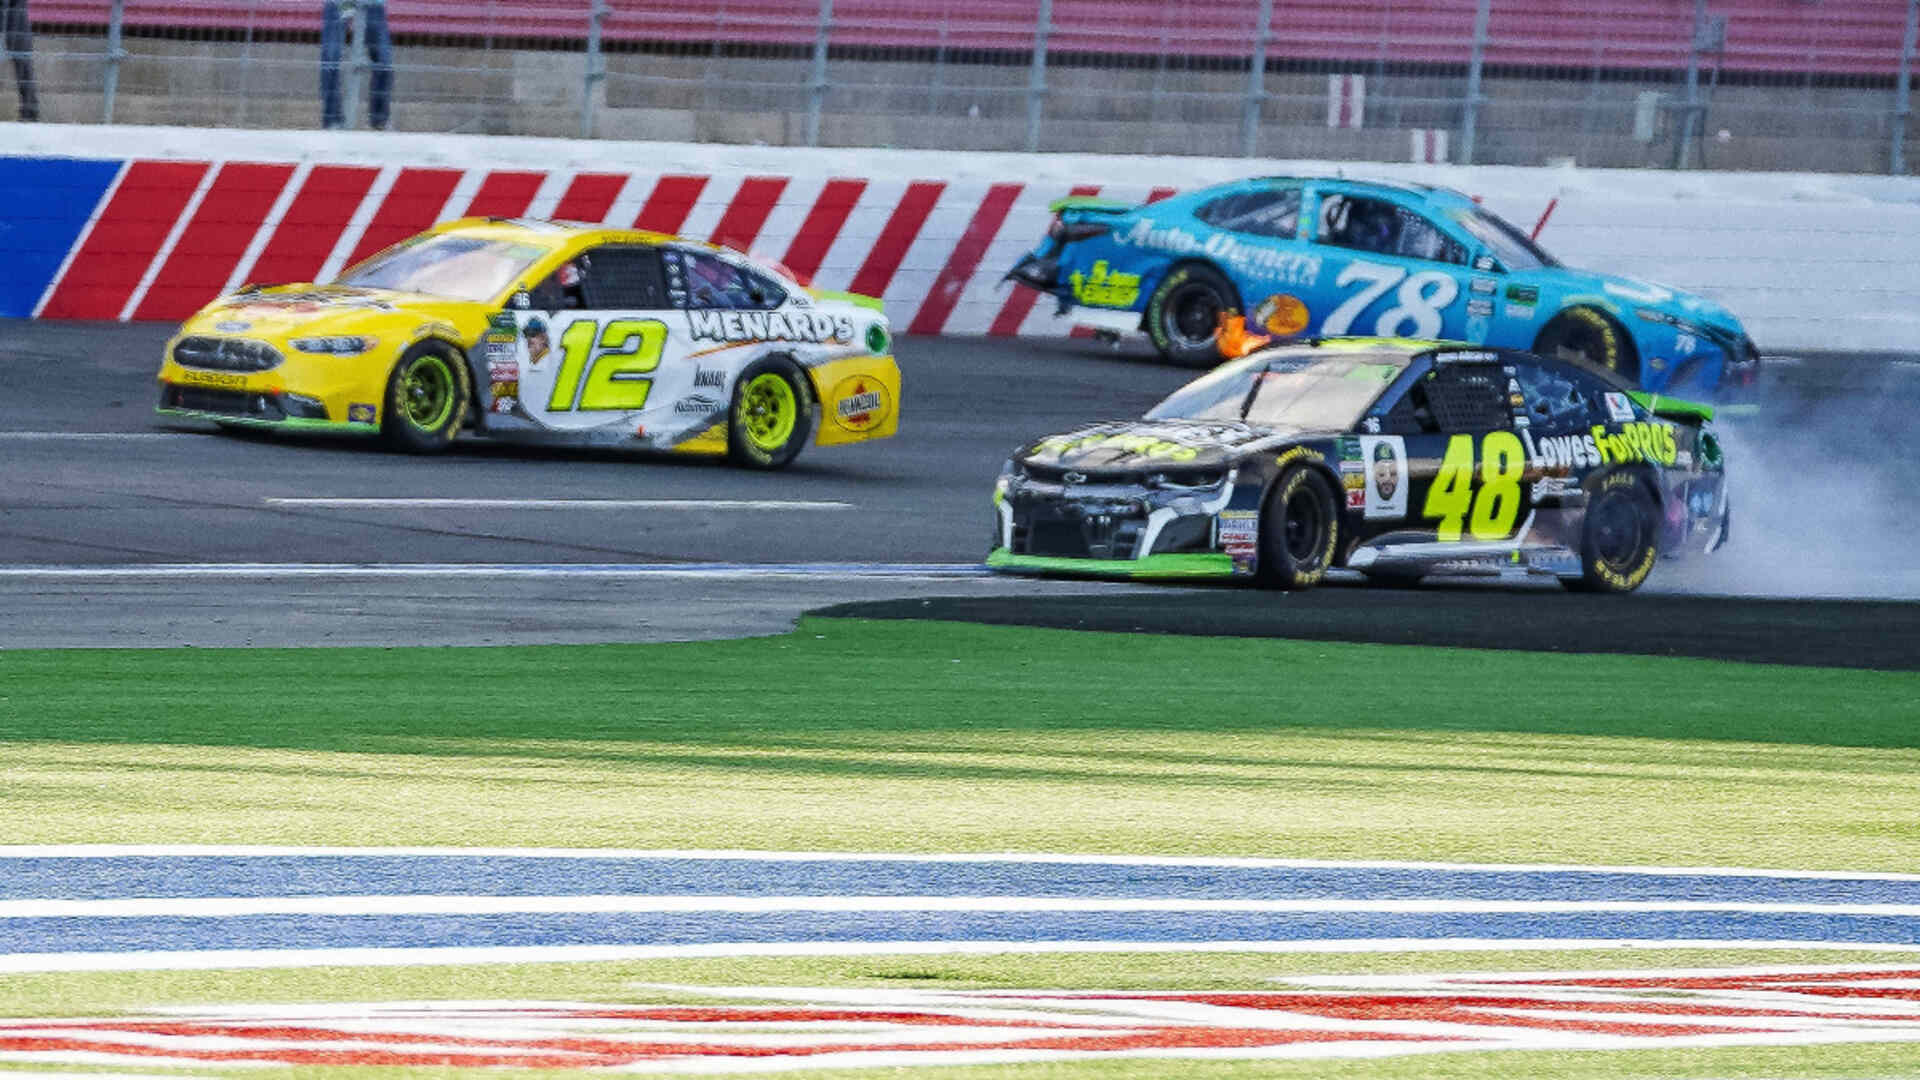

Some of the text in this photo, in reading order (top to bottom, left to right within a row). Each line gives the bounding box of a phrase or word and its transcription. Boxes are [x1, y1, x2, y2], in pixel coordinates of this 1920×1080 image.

[1113, 218, 1322, 278] Auto-Owners
[686, 309, 856, 344] MENARDS
[1320, 258, 1459, 340] 78
[546, 318, 669, 412] 12
[1423, 430, 1526, 542] 48
